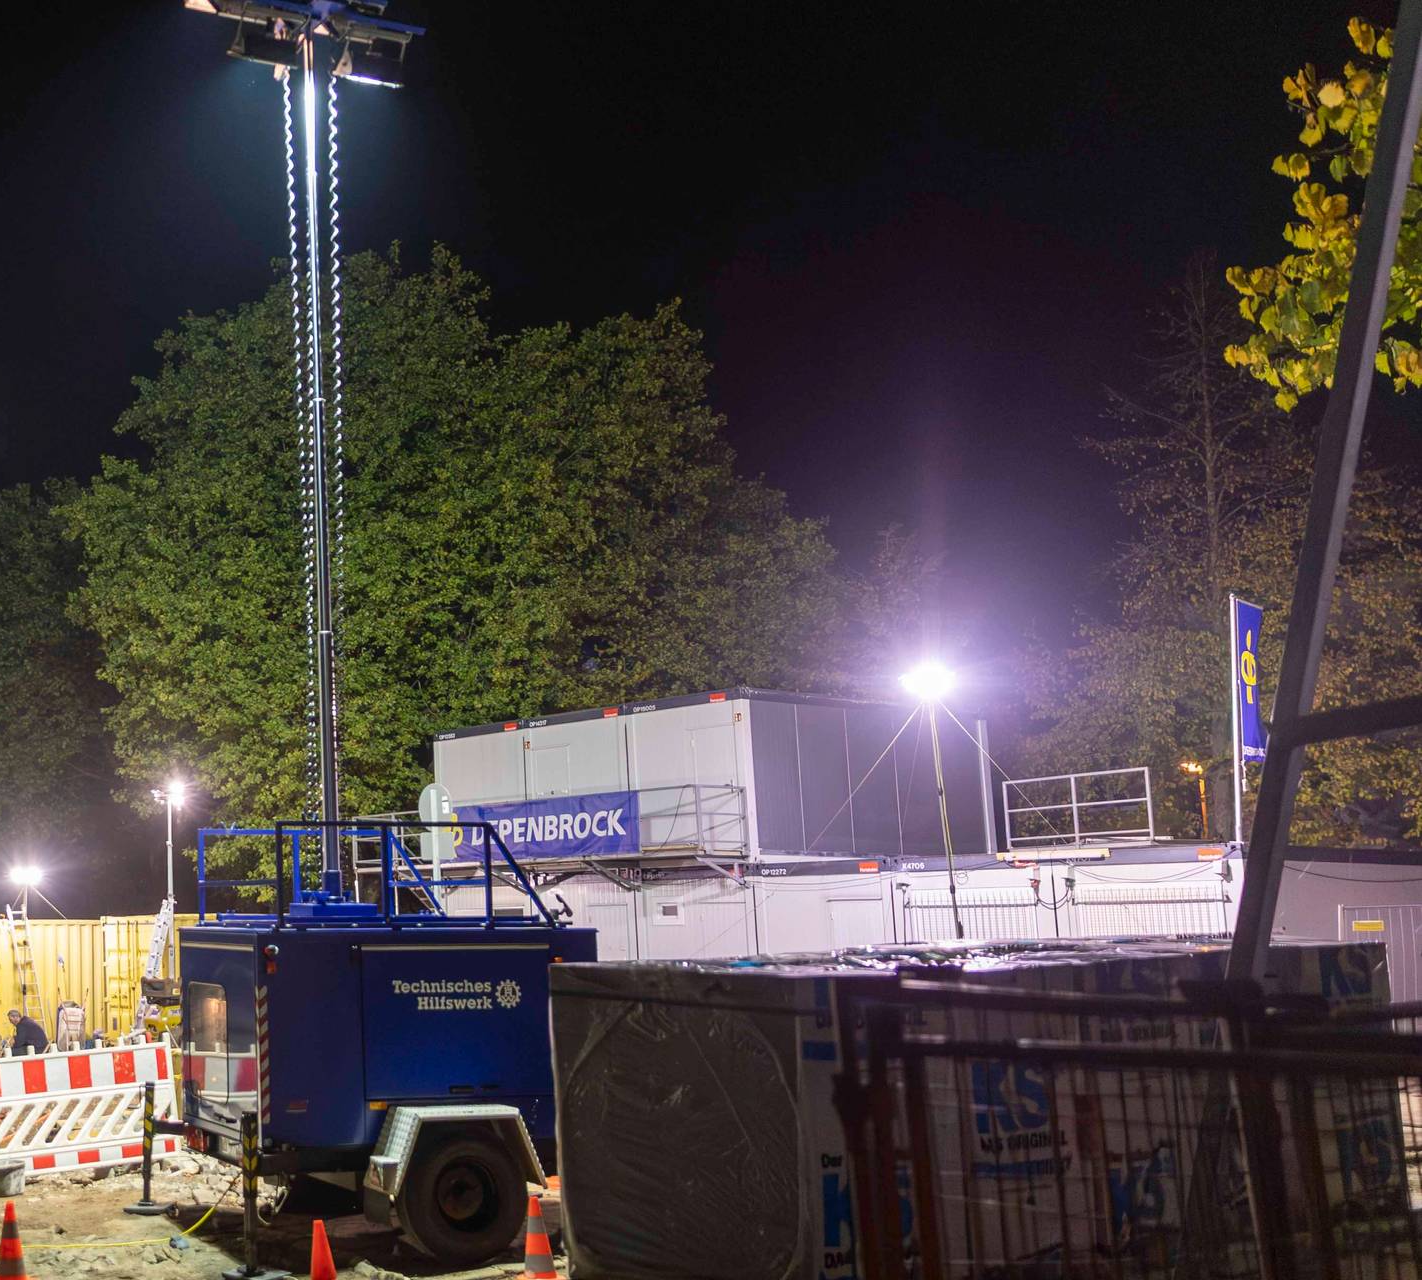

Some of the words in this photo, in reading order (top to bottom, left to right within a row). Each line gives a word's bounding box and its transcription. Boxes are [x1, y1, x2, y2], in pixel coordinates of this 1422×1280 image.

[392, 980, 492, 993] Technisches
[417, 996, 493, 1010] Hilfswerk
[972, 1061, 1050, 1134] KS
[1008, 1130, 1068, 1150] ORIGINL
